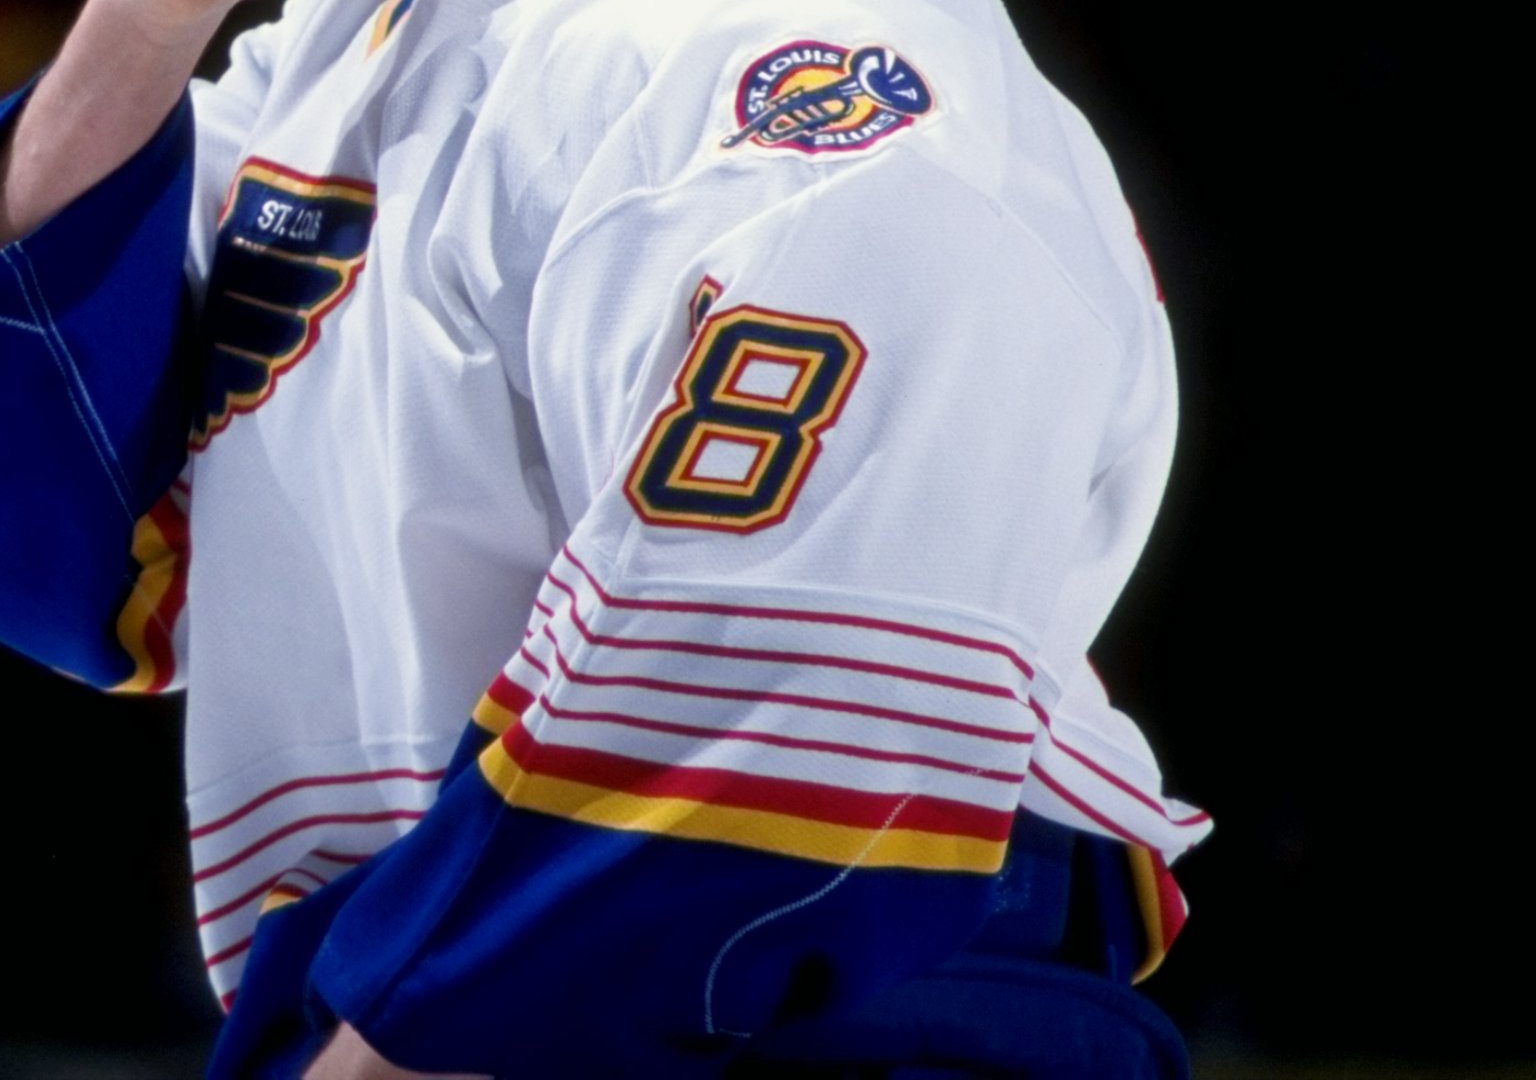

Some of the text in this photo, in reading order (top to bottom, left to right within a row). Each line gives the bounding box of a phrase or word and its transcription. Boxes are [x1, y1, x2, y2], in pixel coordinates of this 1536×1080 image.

[757, 48, 841, 83] LOUIS
[814, 111, 898, 146] BLUES
[257, 199, 293, 237] ST.
